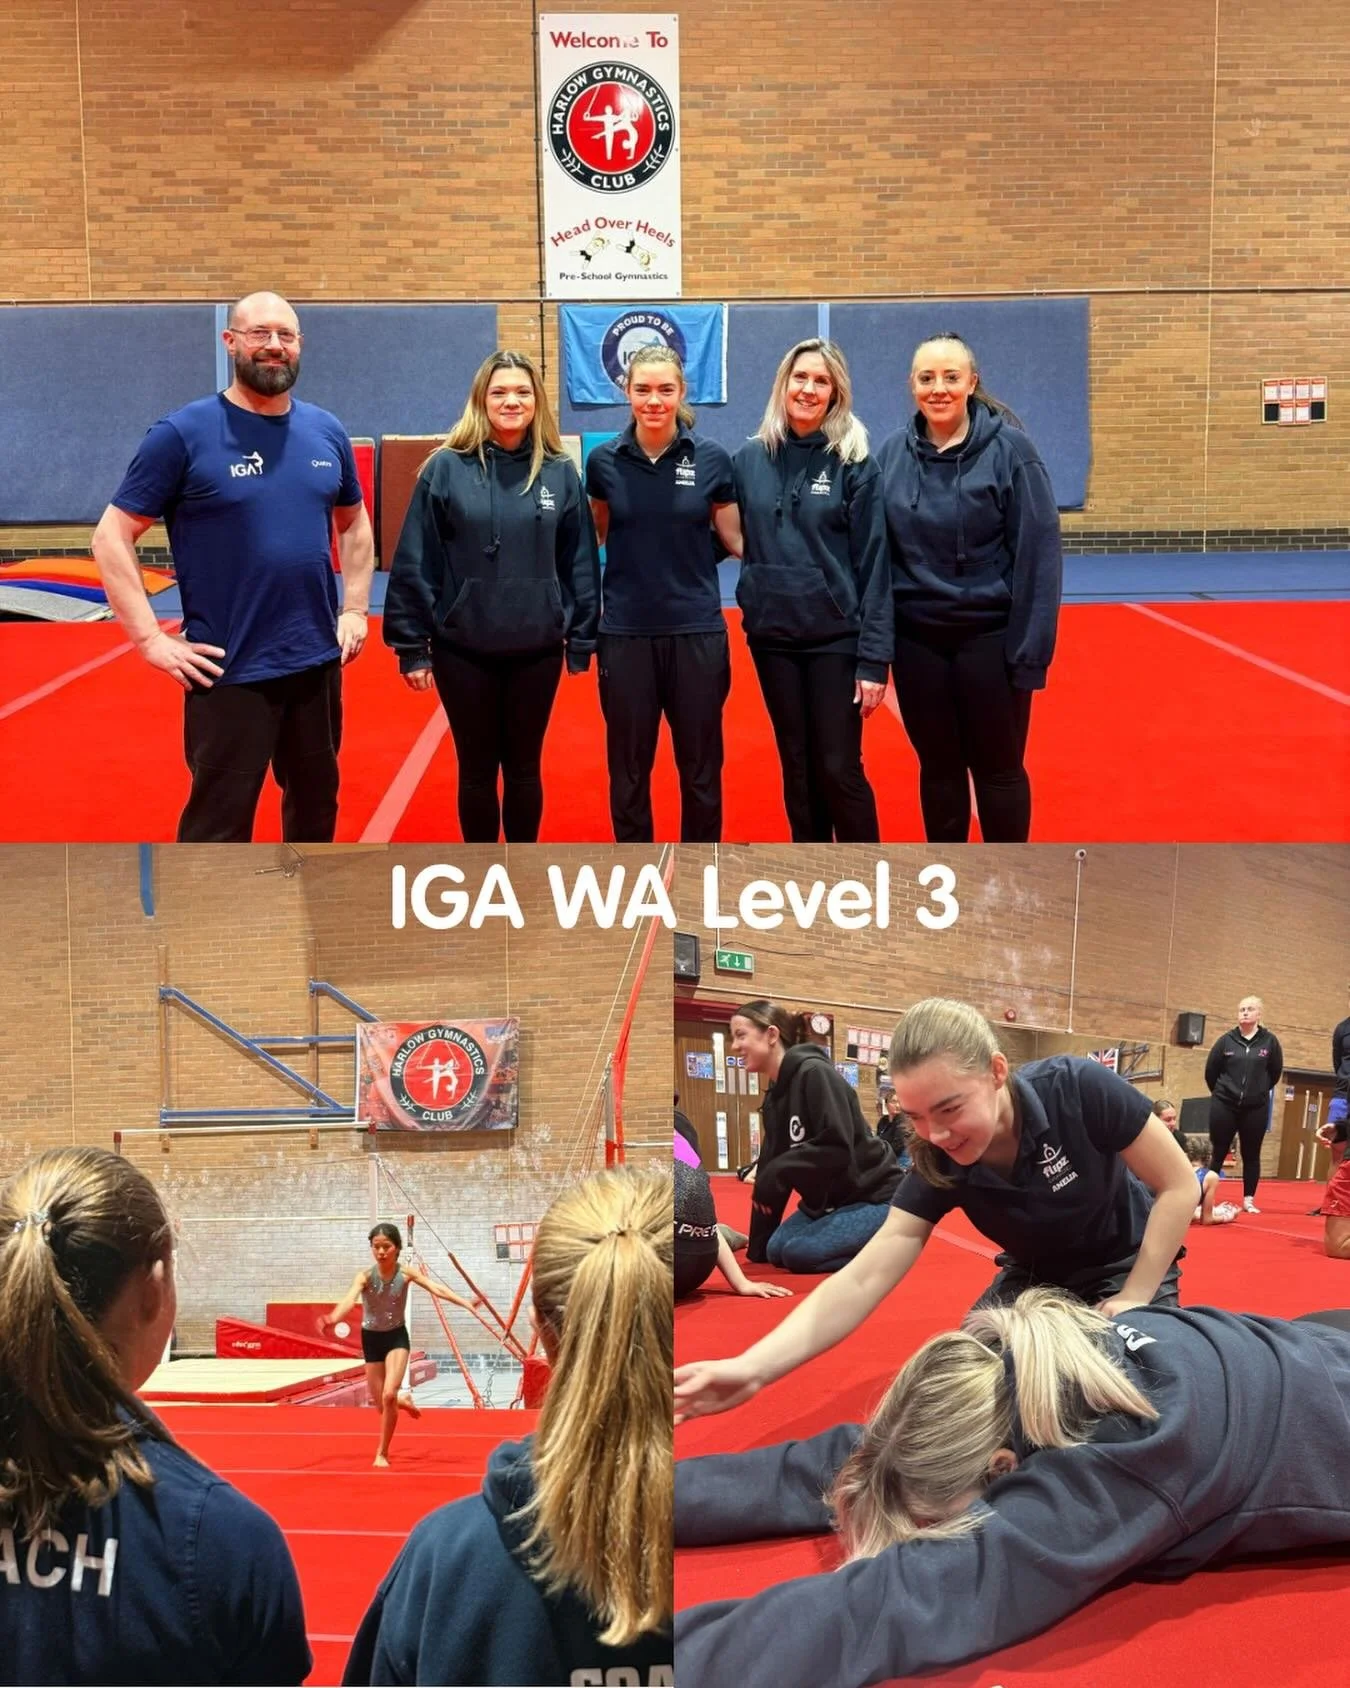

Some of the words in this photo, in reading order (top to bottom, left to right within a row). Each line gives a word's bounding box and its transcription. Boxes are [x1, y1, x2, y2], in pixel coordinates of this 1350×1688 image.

[646, 31, 668, 48] To
[552, 74, 588, 134] HARLOW
[593, 67, 670, 131] GYMNASTICS
[591, 173, 636, 188] CLUB
[550, 219, 591, 247] Head
[594, 216, 632, 229] Over
[635, 219, 676, 248] Heels
[559, 272, 612, 280] Pre-School
[615, 272, 668, 281] Gymnastics
[612, 315, 646, 336] PROUD
[647, 315, 662, 326] TO
[661, 322, 675, 336] BE
[230, 463, 257, 478] IGA
[391, 1033, 425, 1076] HARLOW
[428, 1028, 485, 1075] GYMNASTICS
[422, 1110, 453, 1121] CLUB
